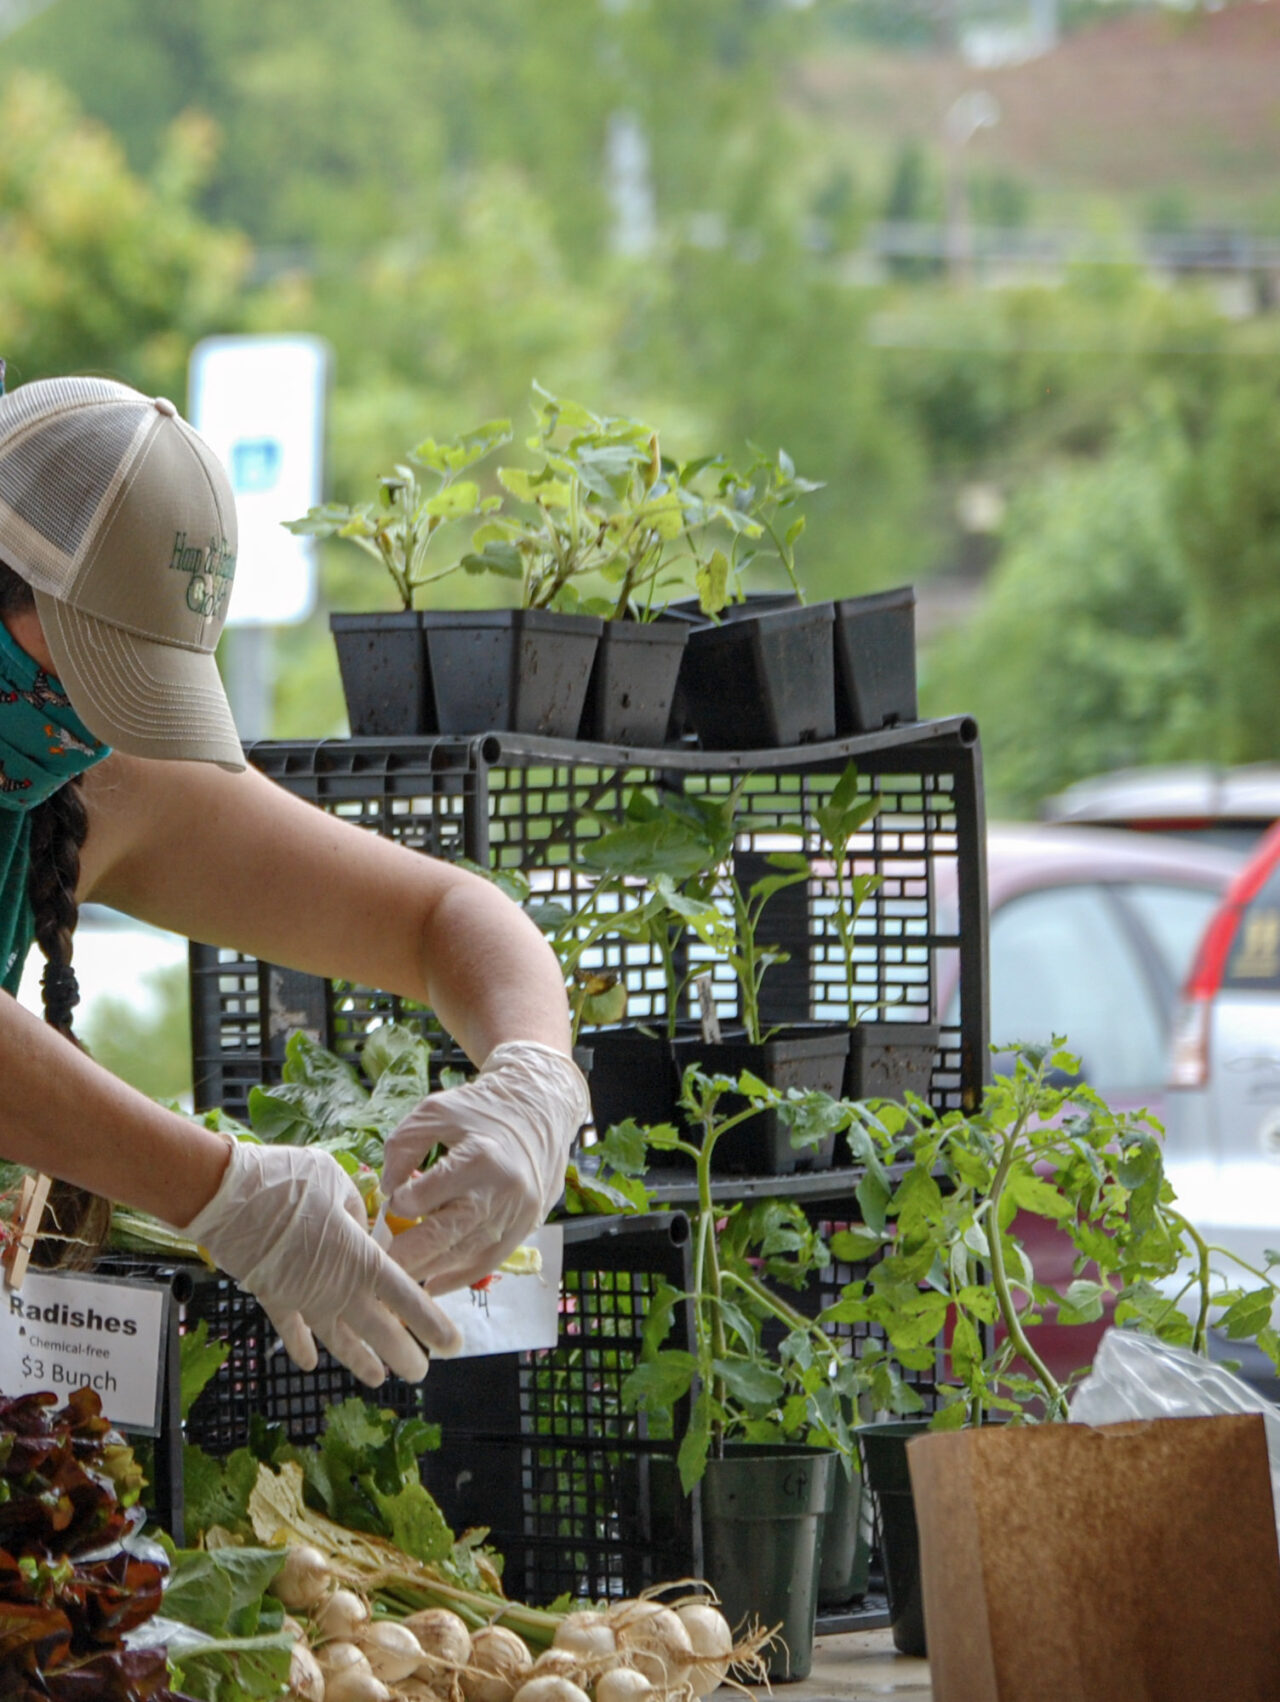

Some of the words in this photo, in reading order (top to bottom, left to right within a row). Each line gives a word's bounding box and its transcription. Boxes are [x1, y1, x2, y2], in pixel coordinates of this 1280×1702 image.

[9, 1296, 138, 1336] Radishes
[29, 1335, 110, 1359] Chemical-free
[21, 1355, 45, 1379] $3
[51, 1363, 117, 1392] Bunch
